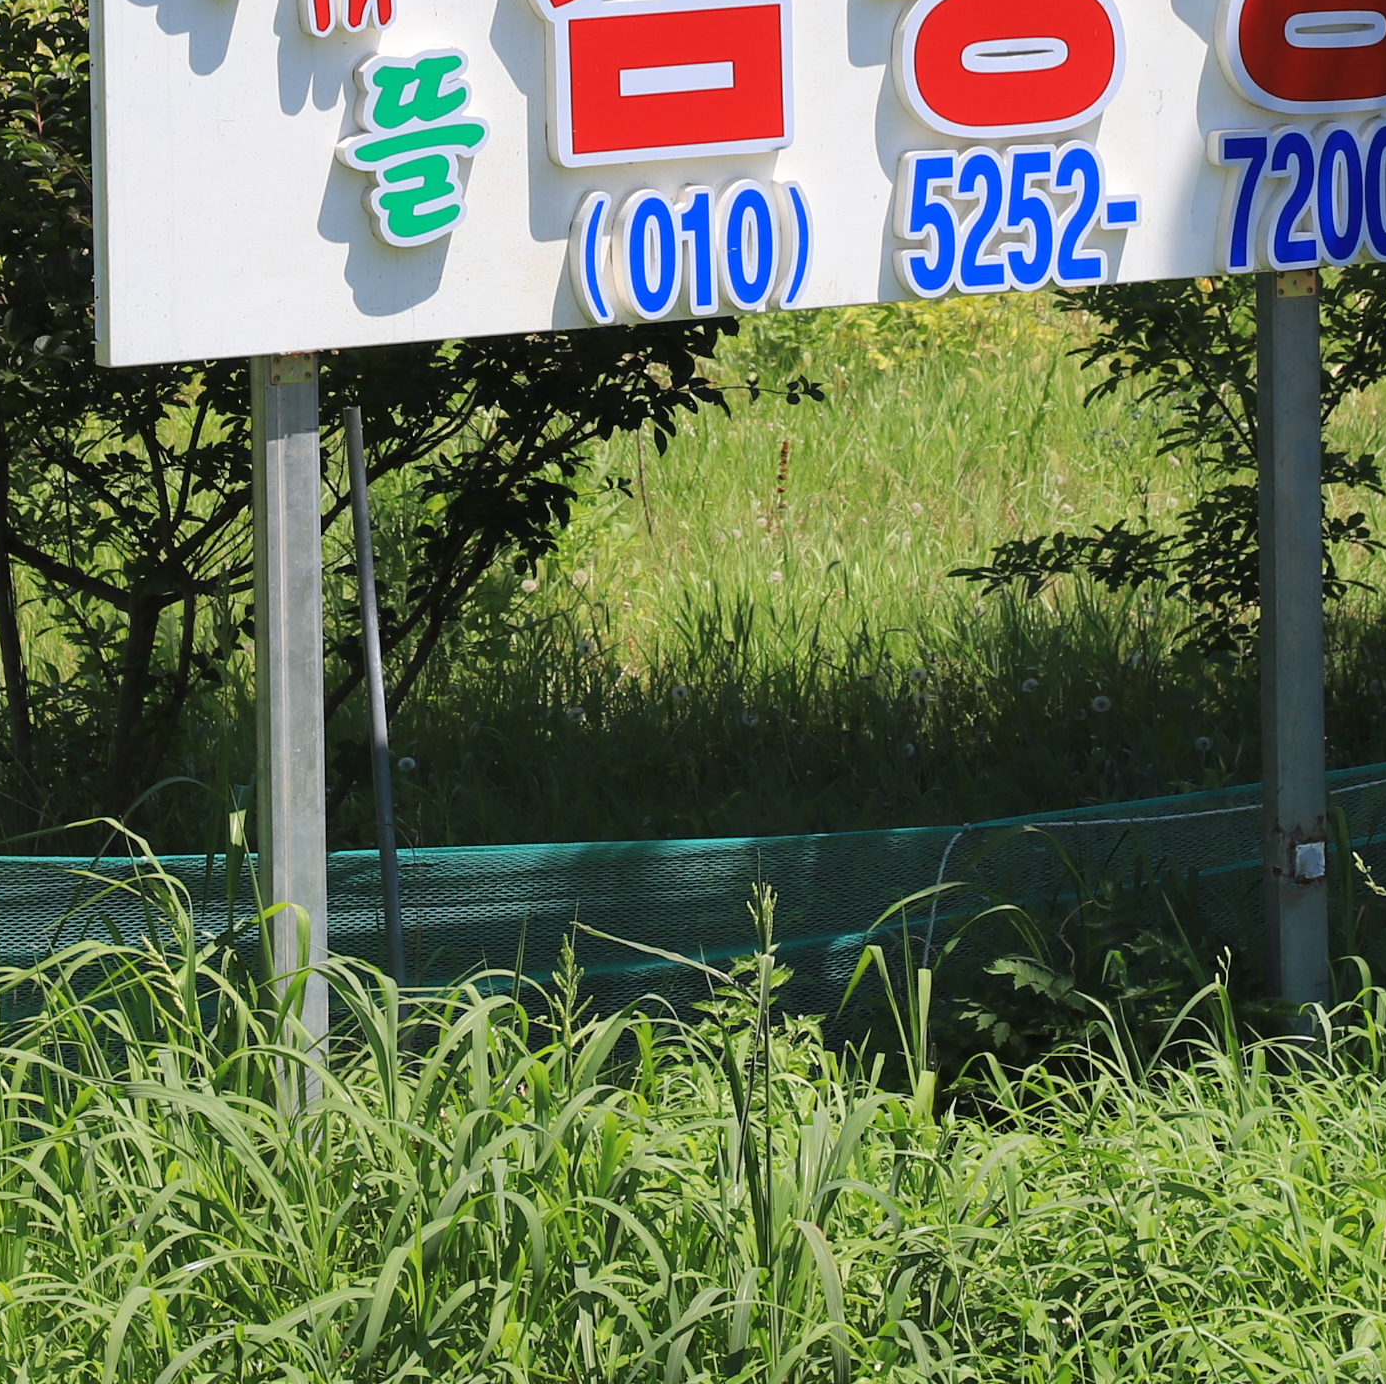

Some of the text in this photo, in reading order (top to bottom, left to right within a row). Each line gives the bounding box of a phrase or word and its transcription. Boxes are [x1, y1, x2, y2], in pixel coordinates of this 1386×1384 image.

[354, 54, 485, 238] 뜰
[585, 186, 811, 319] (010)
[910, 147, 1138, 292] 5252-
